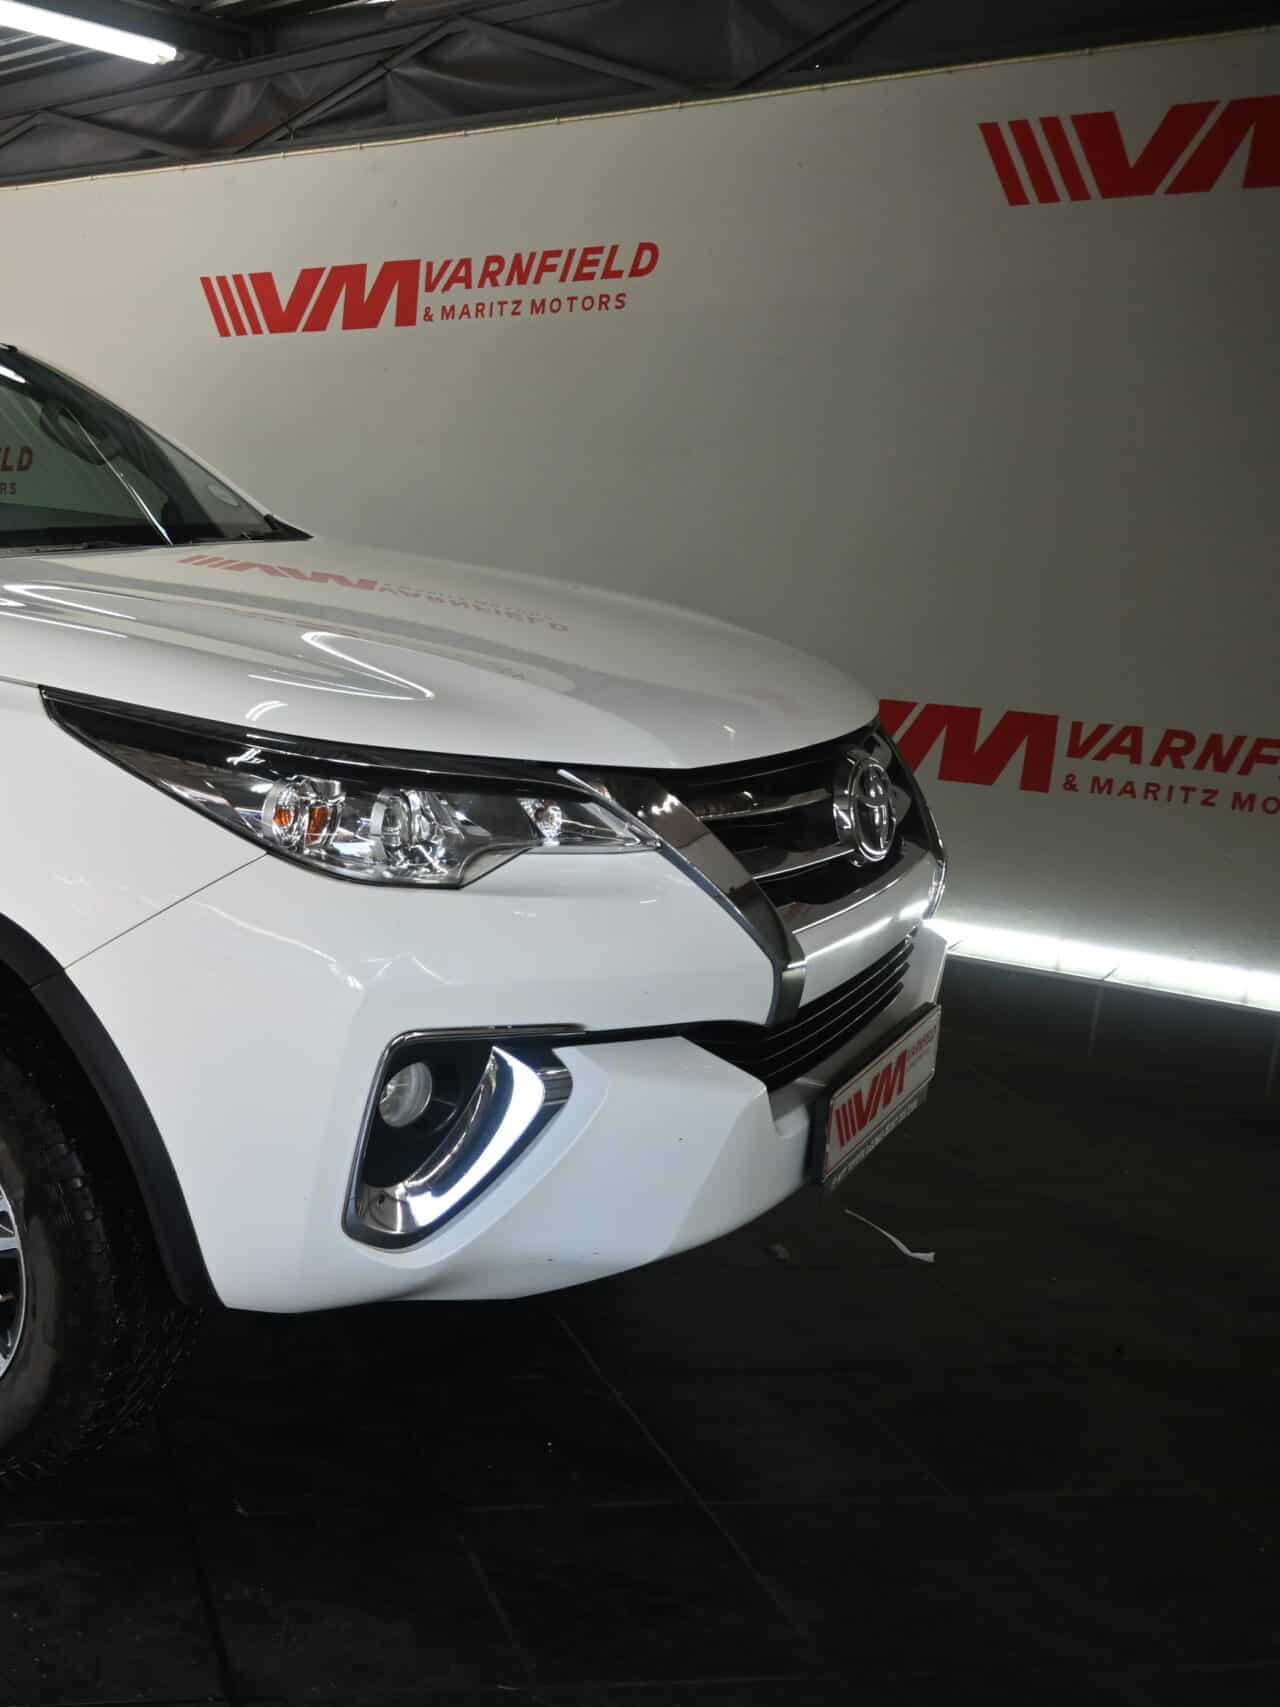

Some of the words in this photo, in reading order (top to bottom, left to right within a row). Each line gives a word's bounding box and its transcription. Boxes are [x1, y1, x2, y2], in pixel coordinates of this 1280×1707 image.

[249, 258, 421, 334] VM
[424, 242, 660, 294] VARNFIELD
[423, 306, 435, 322] &
[440, 300, 523, 321] MARITZ
[530, 293, 627, 316] MOTORS
[1066, 721, 1280, 777] VARNF
[1062, 773, 1079, 793] &
[1090, 775, 1220, 808] MARITZ
